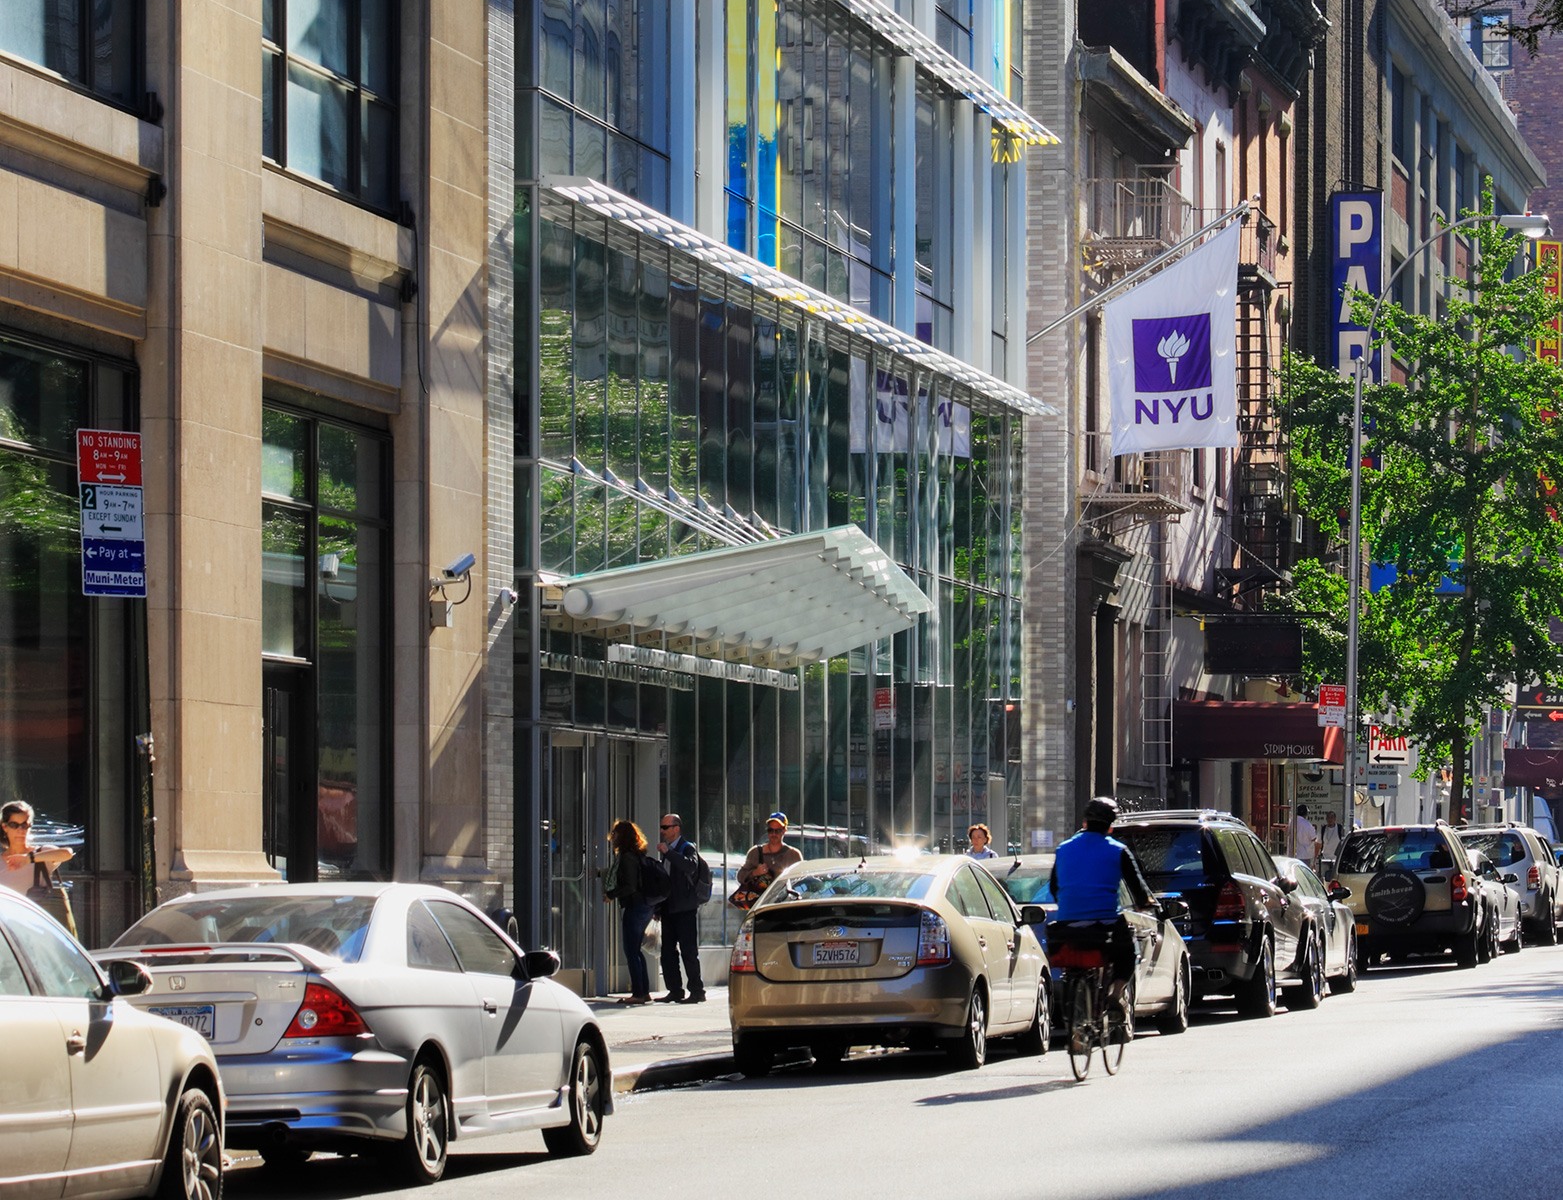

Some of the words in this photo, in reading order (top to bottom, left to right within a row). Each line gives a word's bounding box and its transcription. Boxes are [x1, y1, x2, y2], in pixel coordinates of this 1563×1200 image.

[1135, 393, 1213, 425] NYU
[82, 435, 94, 447] NO
[98, 436, 137, 450] STANDING
[84, 488, 94, 508] 2
[88, 511, 111, 521] EXCEPT
[113, 512, 137, 523] SUNDAY
[99, 546, 116, 560] Pay
[118, 548, 128, 559] at
[86, 572, 143, 586] Muni-Meter
[1287, 744, 1315, 756] HOUSE
[816, 949, 856, 961] 5ZVH576
